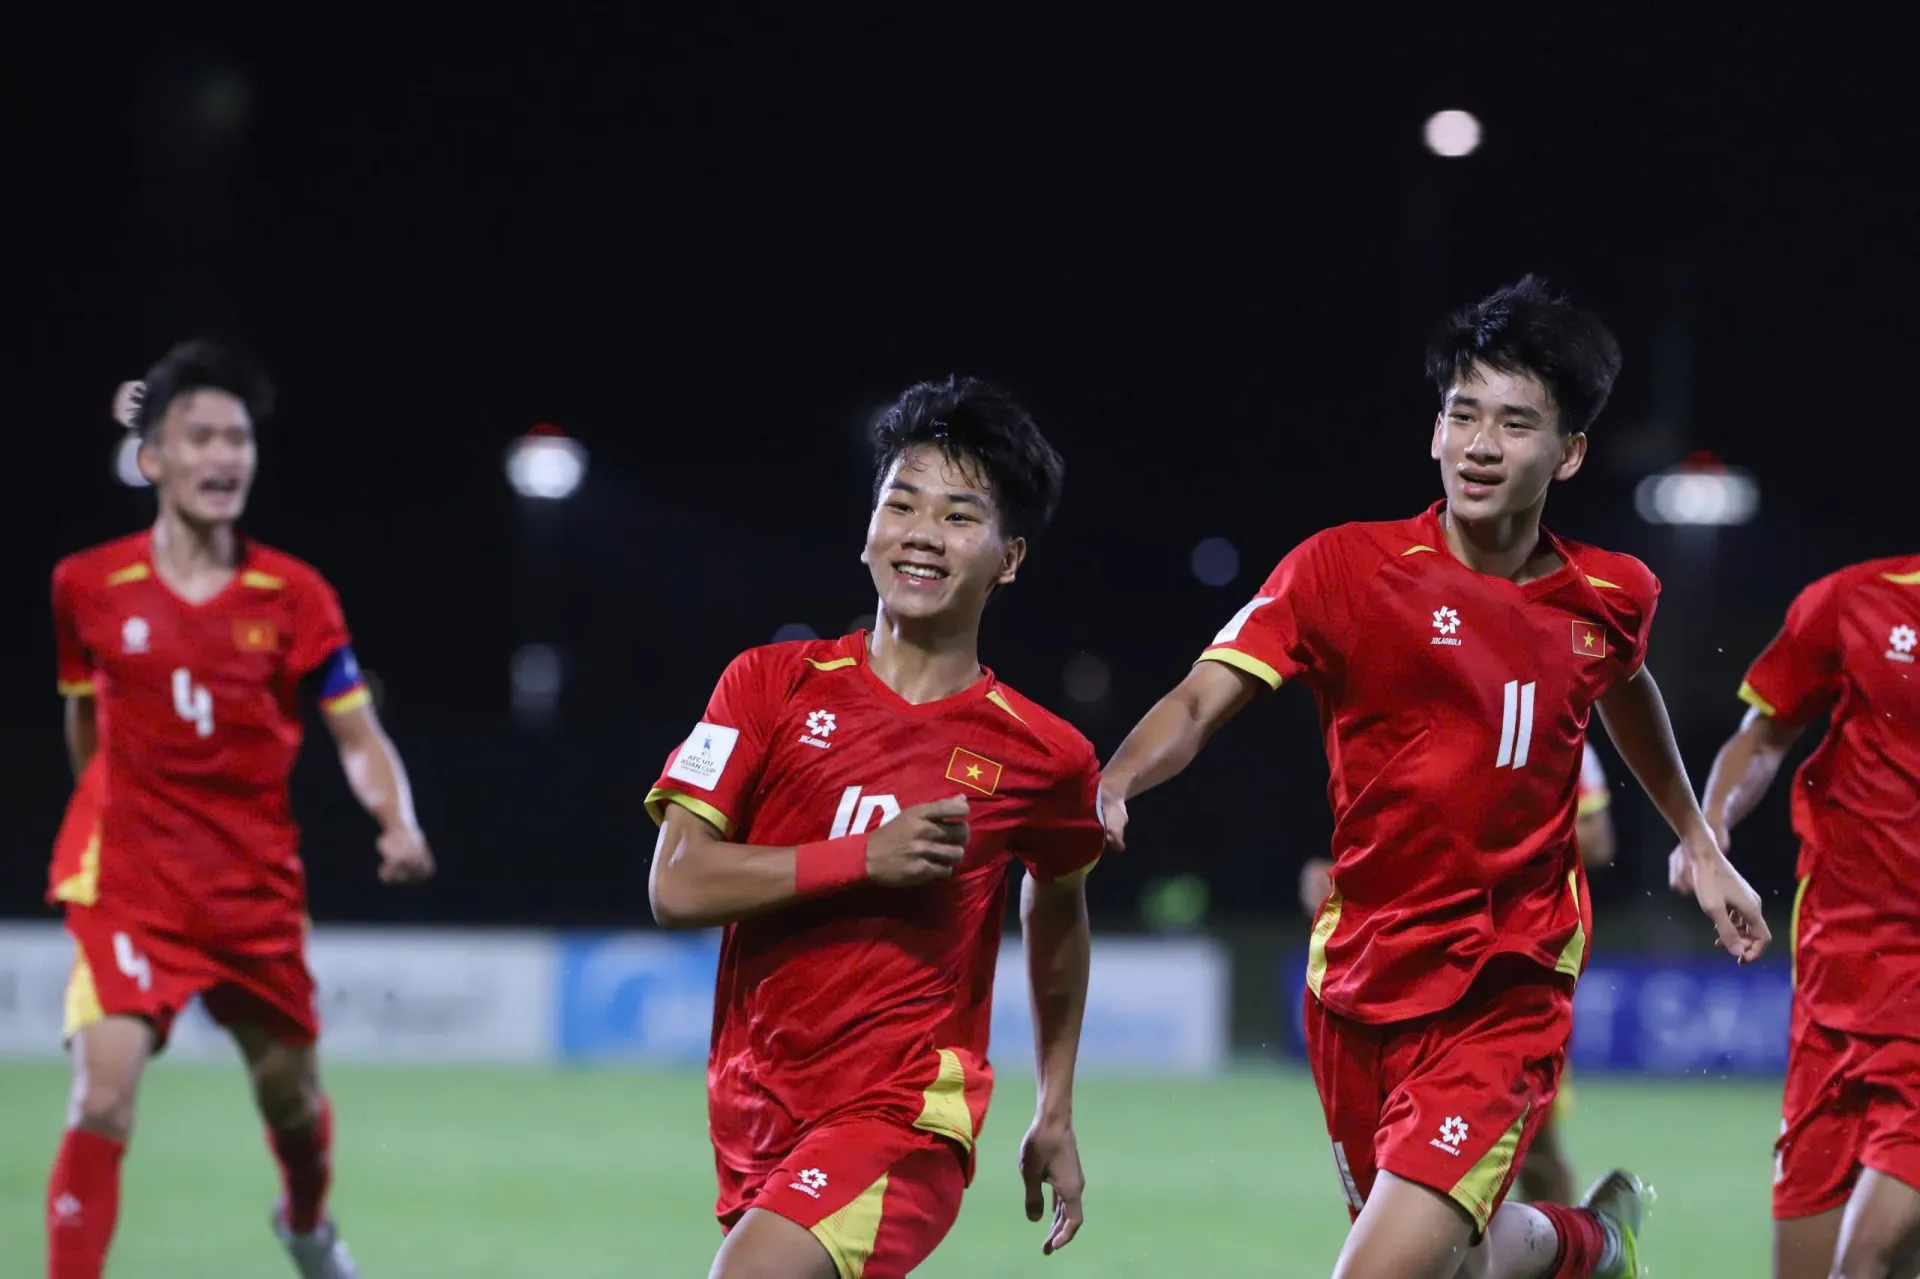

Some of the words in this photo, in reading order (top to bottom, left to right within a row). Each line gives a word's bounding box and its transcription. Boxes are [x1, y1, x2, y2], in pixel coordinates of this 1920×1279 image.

[172, 667, 214, 738] 4
[1495, 679, 1536, 771] 11
[680, 758, 701, 770] ASIAN
[701, 765, 716, 774] CUP
[112, 930, 153, 992] 4
